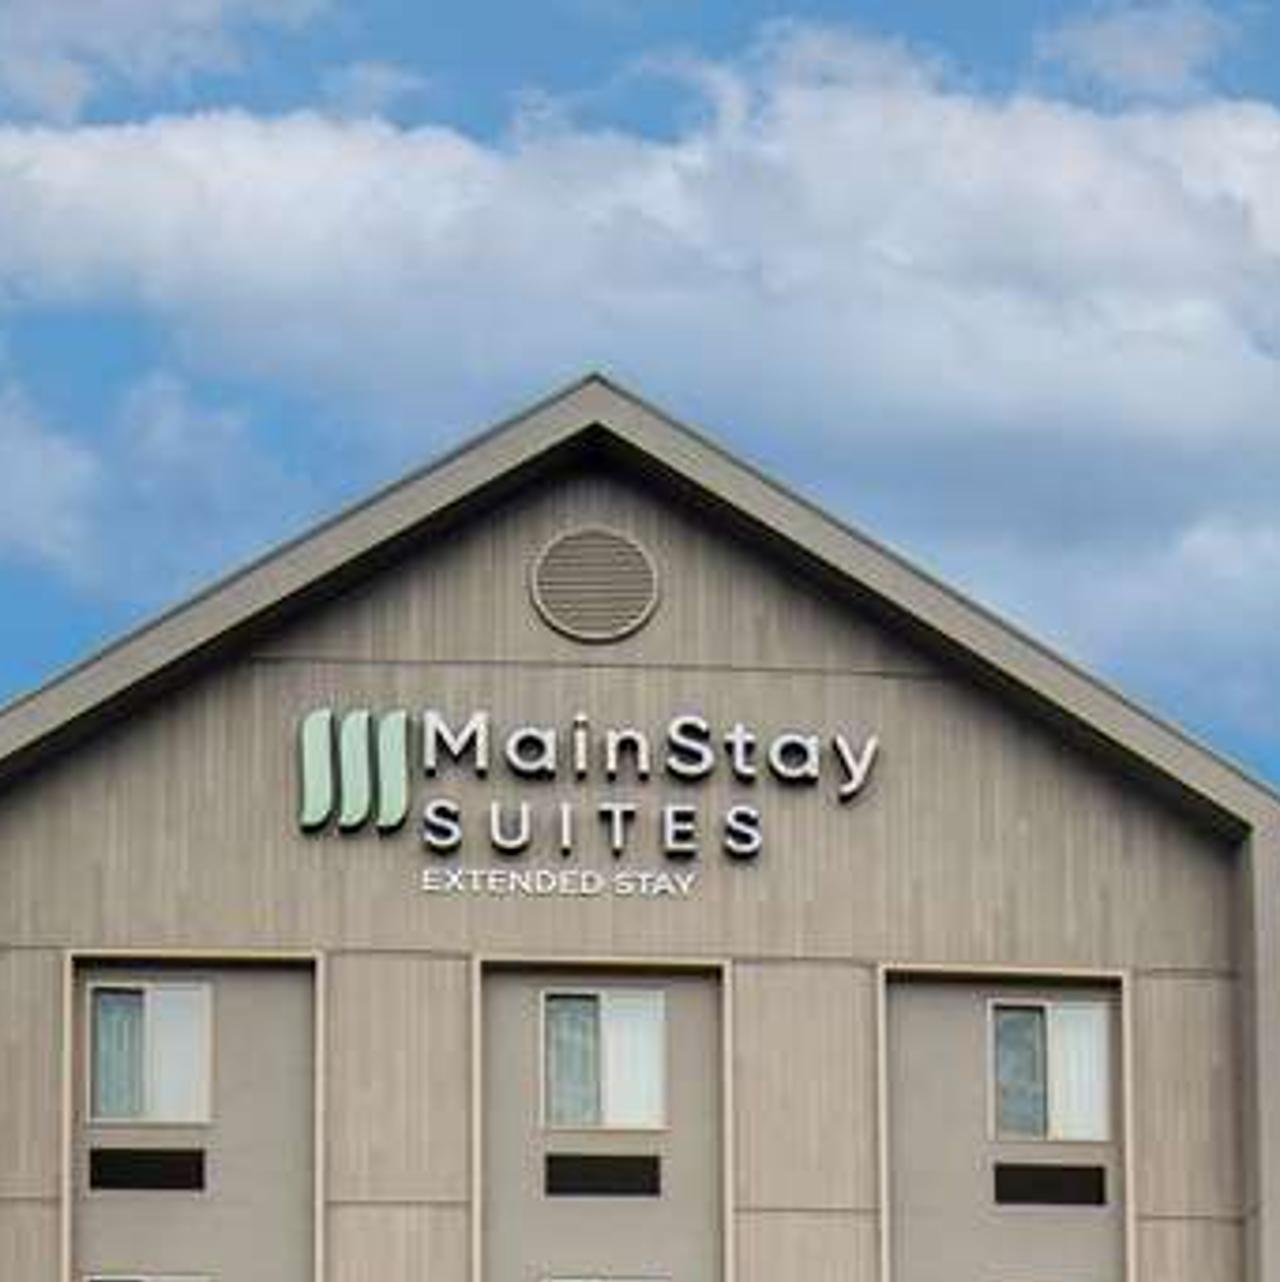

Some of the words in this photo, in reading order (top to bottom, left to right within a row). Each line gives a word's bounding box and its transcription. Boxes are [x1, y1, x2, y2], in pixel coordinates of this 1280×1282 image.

[422, 711, 879, 800] MainStay
[423, 799, 763, 856] SUITES
[422, 869, 602, 894] EXTENDED
[615, 872, 698, 895] STAY
